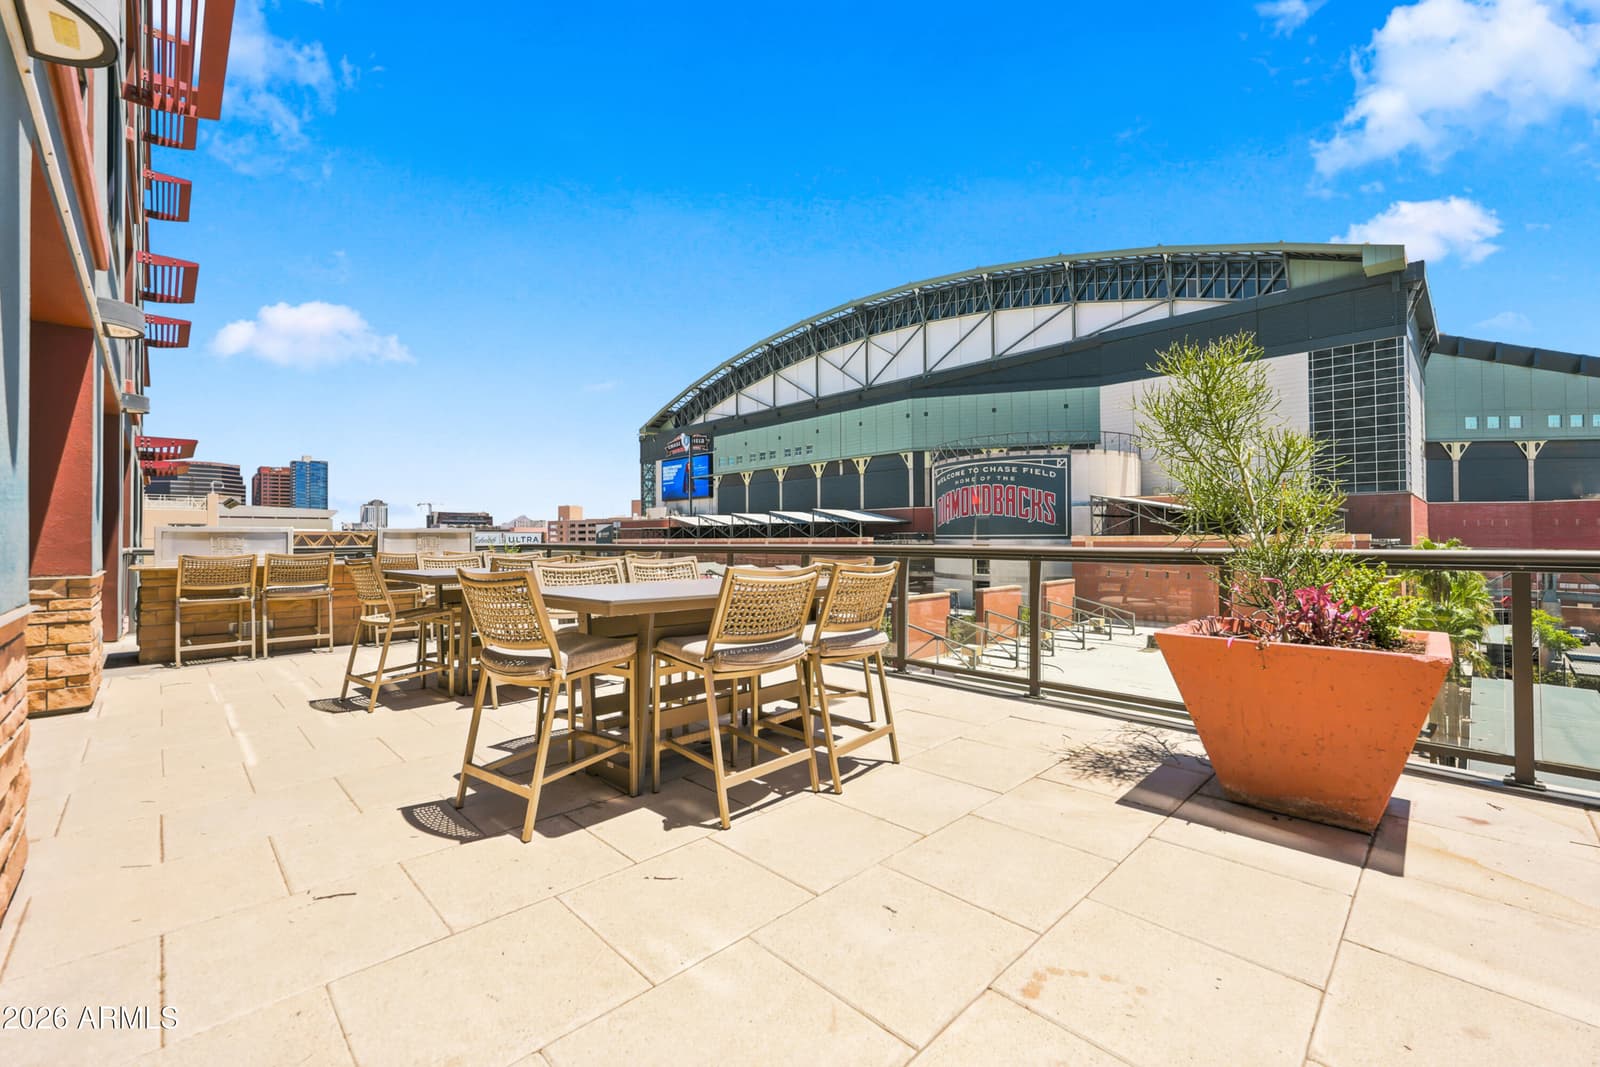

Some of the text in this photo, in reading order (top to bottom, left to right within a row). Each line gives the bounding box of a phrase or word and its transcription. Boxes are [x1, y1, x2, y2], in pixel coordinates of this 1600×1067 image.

[937, 469, 965, 486] WELCOME
[1022, 467, 1057, 478] FIELD
[955, 476, 976, 485] HOME
[937, 483, 1056, 528] DIAMONDBACKS
[508, 536, 539, 544] ULTRA
